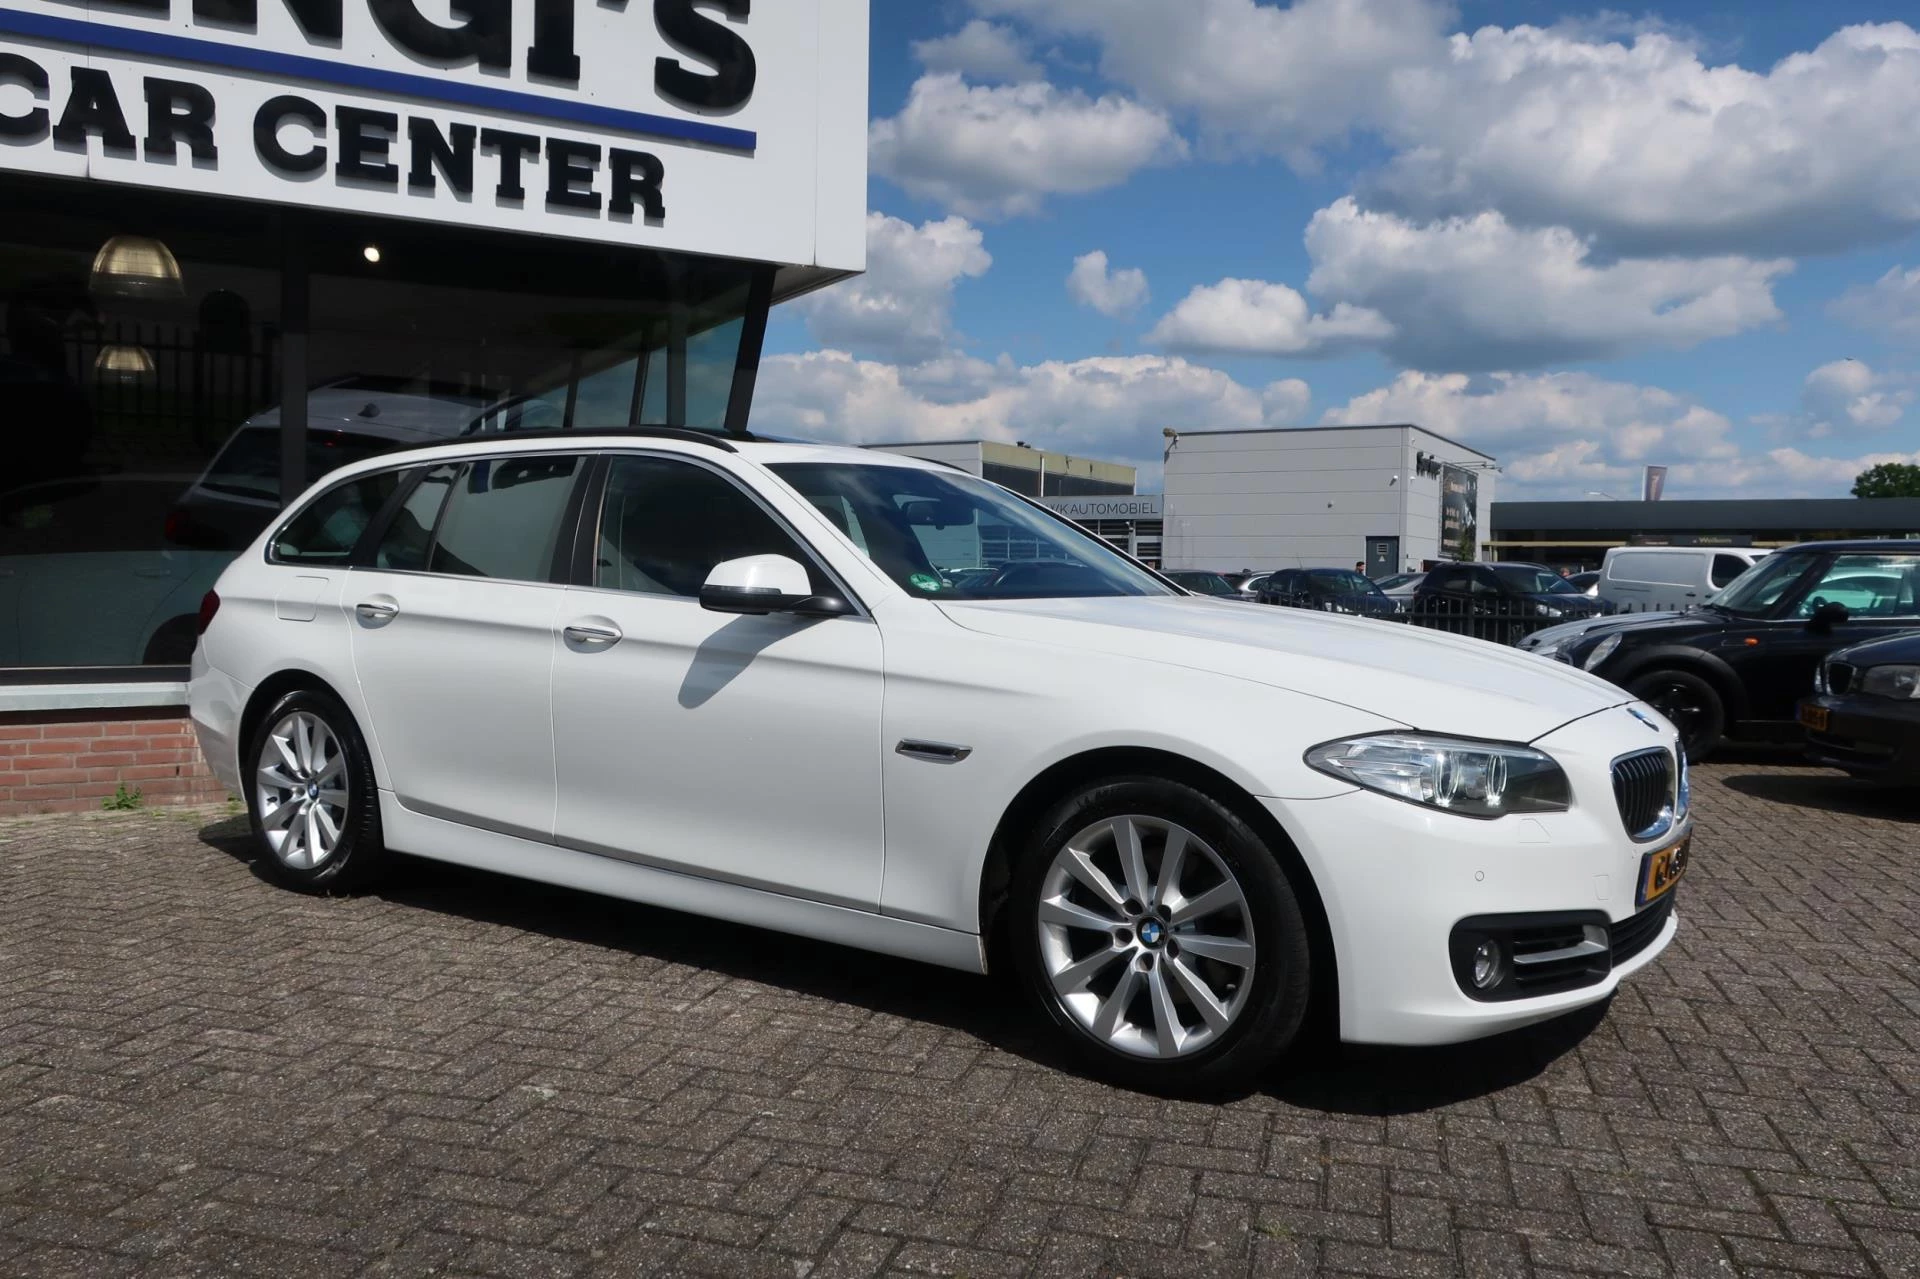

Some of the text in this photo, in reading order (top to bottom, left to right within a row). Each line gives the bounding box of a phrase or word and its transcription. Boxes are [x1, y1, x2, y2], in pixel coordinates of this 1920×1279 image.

[42, 0, 757, 111] GIS
[0, 52, 666, 220] CAR CENTER
